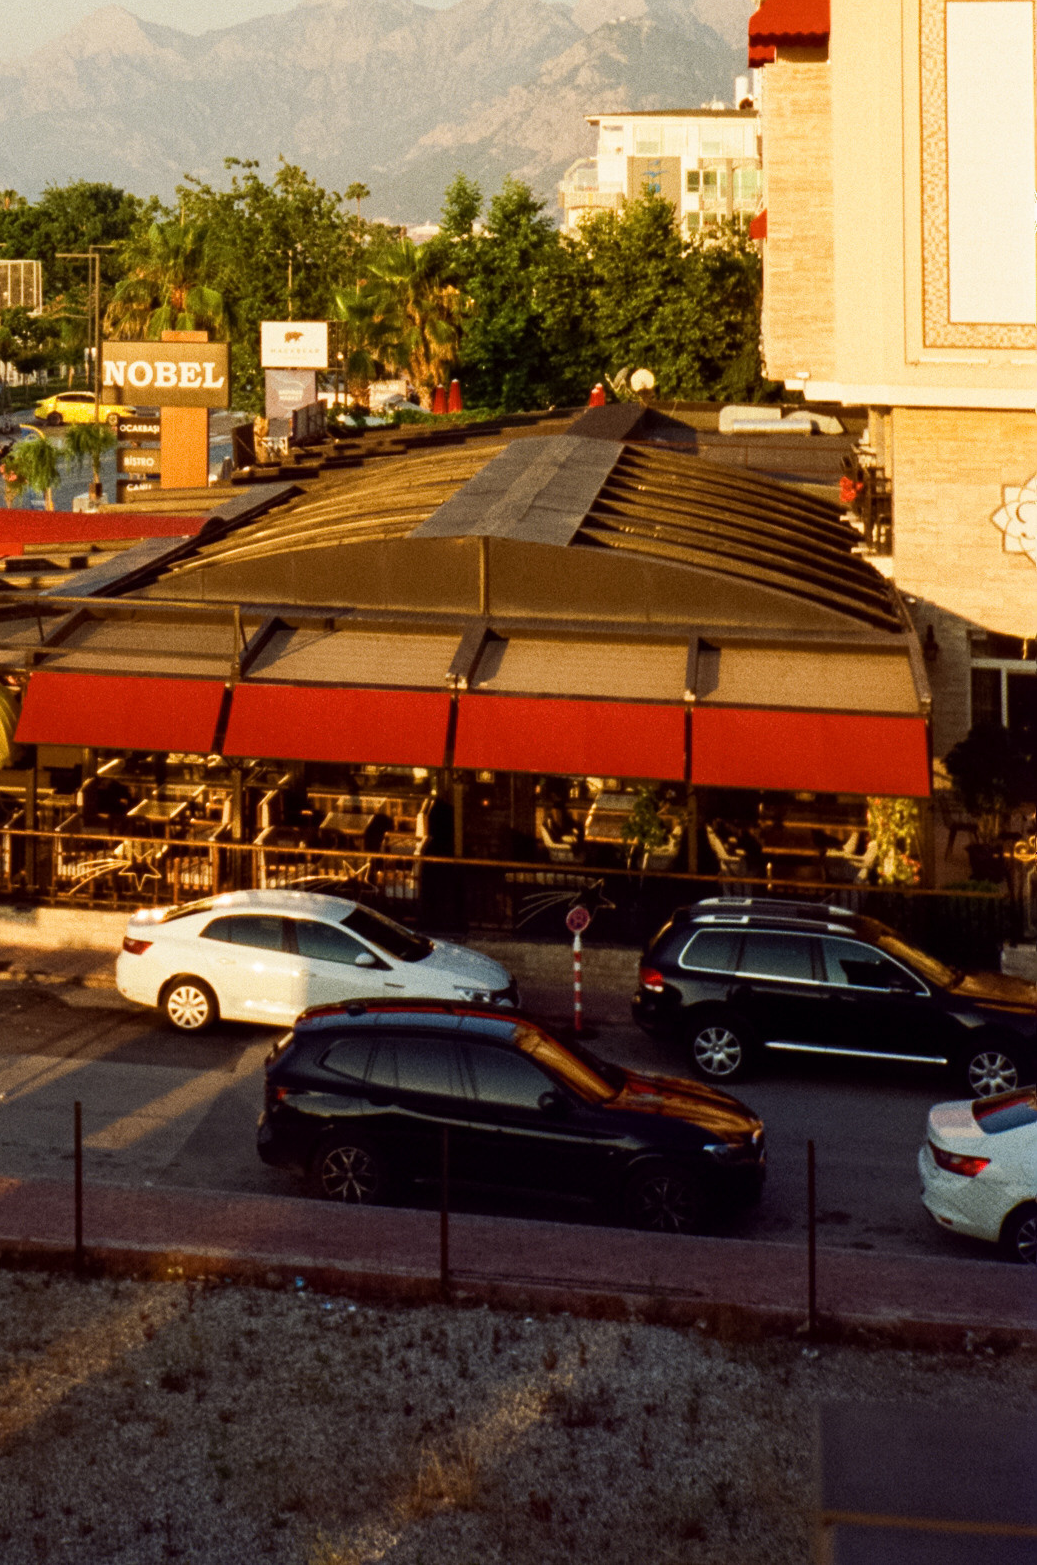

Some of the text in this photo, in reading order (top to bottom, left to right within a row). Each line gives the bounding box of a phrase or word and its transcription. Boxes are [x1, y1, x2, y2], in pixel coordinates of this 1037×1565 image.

[102, 360, 225, 388] NOBEL
[119, 424, 160, 434] OCAKBAŞI
[123, 455, 155, 467] BİSTRO
